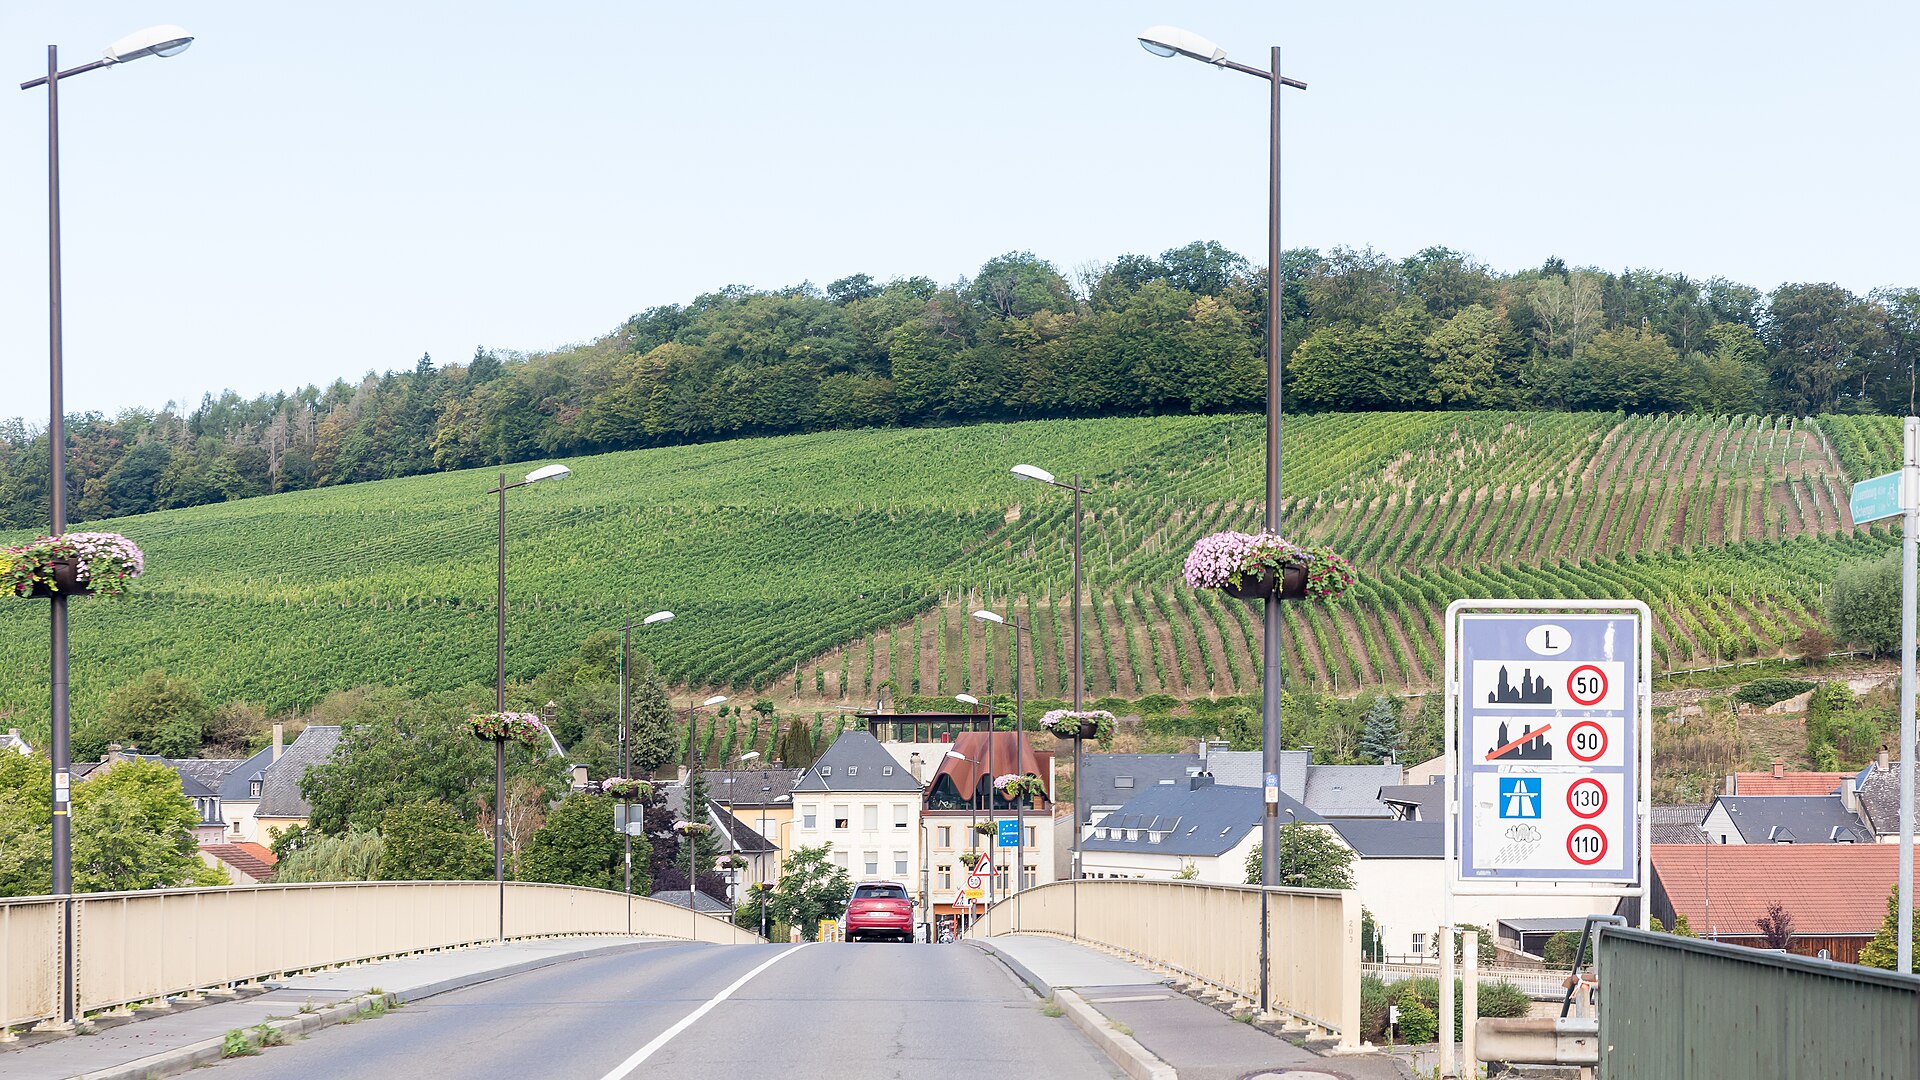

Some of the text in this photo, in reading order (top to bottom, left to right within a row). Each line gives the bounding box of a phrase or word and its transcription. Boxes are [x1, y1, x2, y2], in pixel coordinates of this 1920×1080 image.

[1545, 630, 1558, 649] L
[1577, 677, 1599, 695] 50
[1576, 733, 1598, 751] 90
[1573, 790, 1600, 807] 130
[1574, 836, 1599, 853] 110
